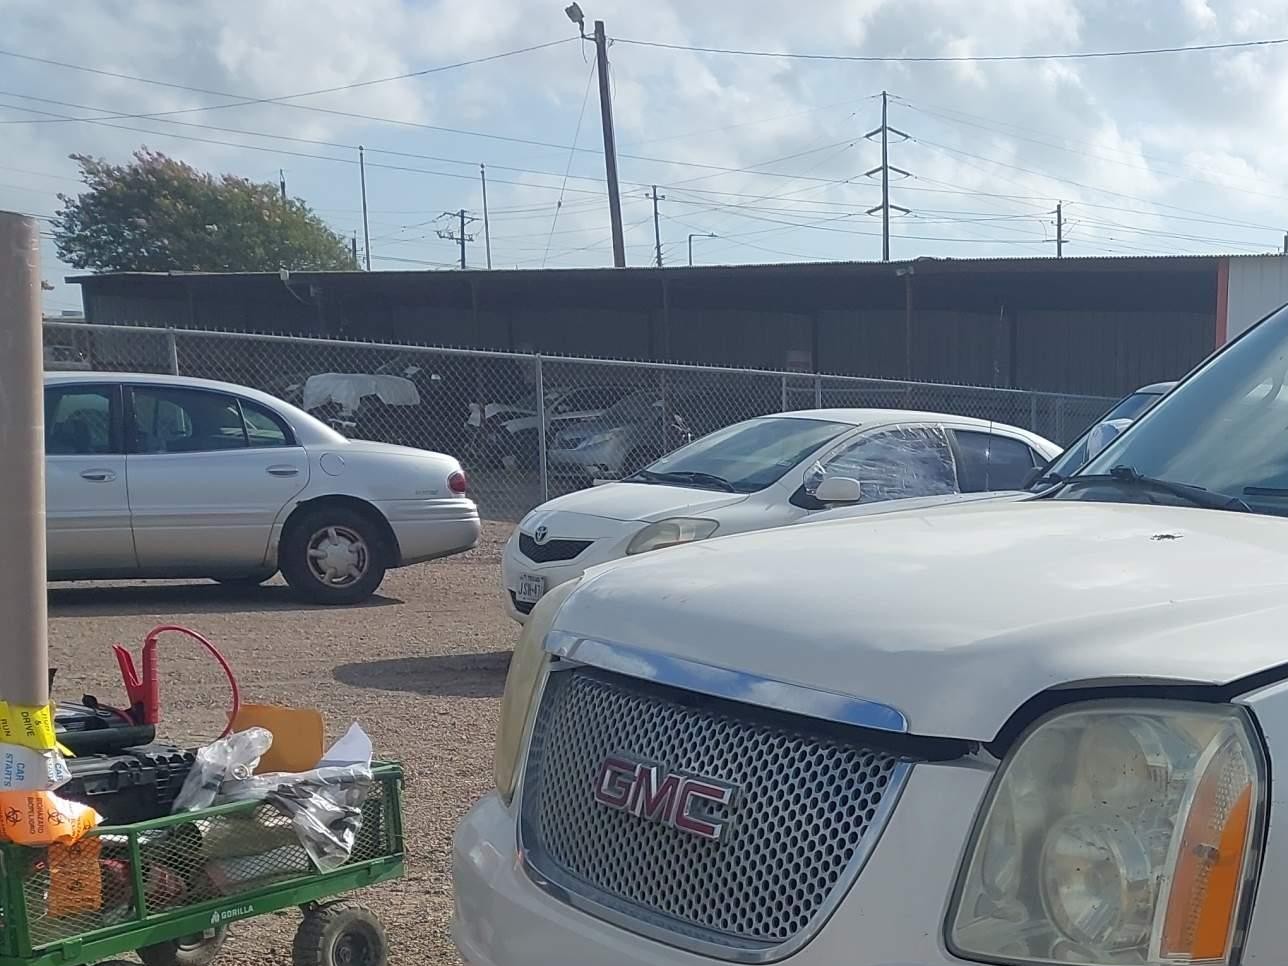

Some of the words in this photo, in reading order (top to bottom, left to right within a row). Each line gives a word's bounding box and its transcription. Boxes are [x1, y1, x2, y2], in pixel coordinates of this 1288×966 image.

[21, 711, 35, 737] DRIVE
[4, 753, 14, 787] STARTS
[16, 763, 25, 782] CAR
[595, 757, 732, 839] GMC
[221, 905, 254, 919] GORILLA
